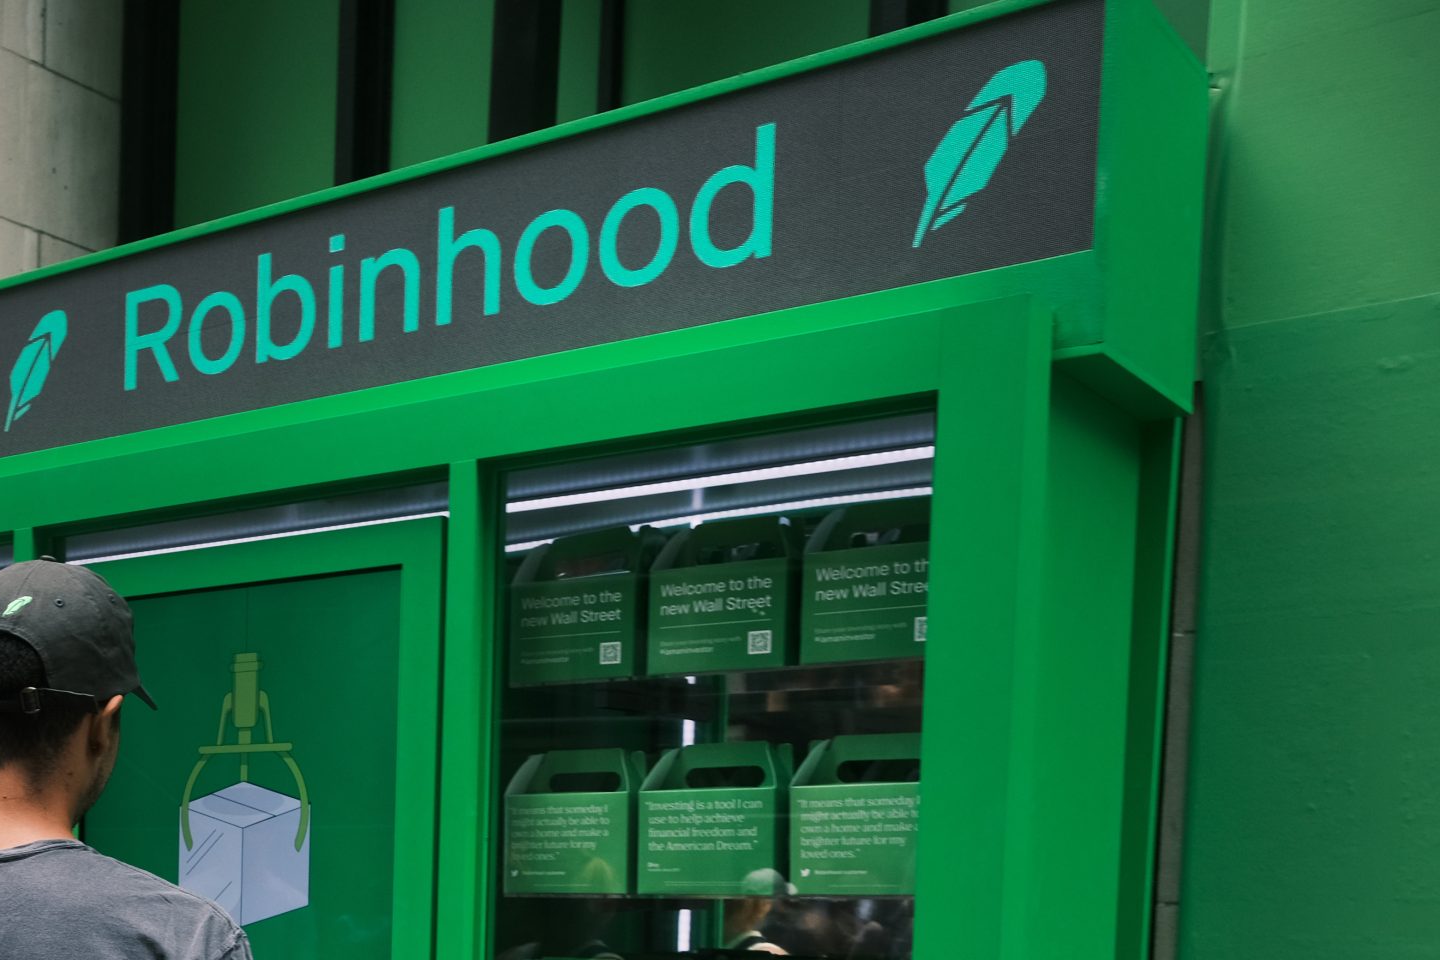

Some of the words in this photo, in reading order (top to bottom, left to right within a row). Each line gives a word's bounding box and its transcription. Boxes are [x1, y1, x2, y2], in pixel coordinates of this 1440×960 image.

[125, 122, 777, 391] Robinhood
[816, 566, 889, 582] Welcome
[894, 561, 910, 575] to
[660, 583, 726, 598] Welcome
[729, 579, 744, 592] to
[748, 577, 772, 590] the
[815, 589, 848, 601] new
[852, 582, 886, 598] Wall
[583, 592, 597, 605] to
[600, 590, 622, 604] the
[659, 605, 688, 616] new
[693, 599, 723, 613] Wall
[726, 594, 771, 611] Street
[550, 611, 578, 625] Wall
[580, 607, 621, 623] Street
[696, 799, 704, 809] is
[706, 801, 714, 809] a
[715, 798, 736, 808] tool
[742, 800, 763, 808] can
[809, 800, 844, 808] means
[845, 797, 864, 807] that
[867, 796, 914, 808] someday
[648, 816, 665, 824] use
[668, 814, 679, 823] to
[680, 813, 702, 825] help
[704, 813, 744, 823] achieve
[830, 809, 870, 821] actually
[871, 809, 885, 819] be
[886, 809, 910, 818] able
[648, 827, 690, 837] financial
[692, 827, 735, 837] freedom
[737, 826, 758, 836] and
[831, 823, 860, 832] home
[862, 822, 882, 832] and
[884, 822, 912, 832] make
[648, 841, 664, 851] the
[666, 841, 714, 851] American
[841, 835, 872, 845] future
[872, 835, 887, 845] for
[888, 837, 906, 847] my
[800, 848, 828, 858] loved
